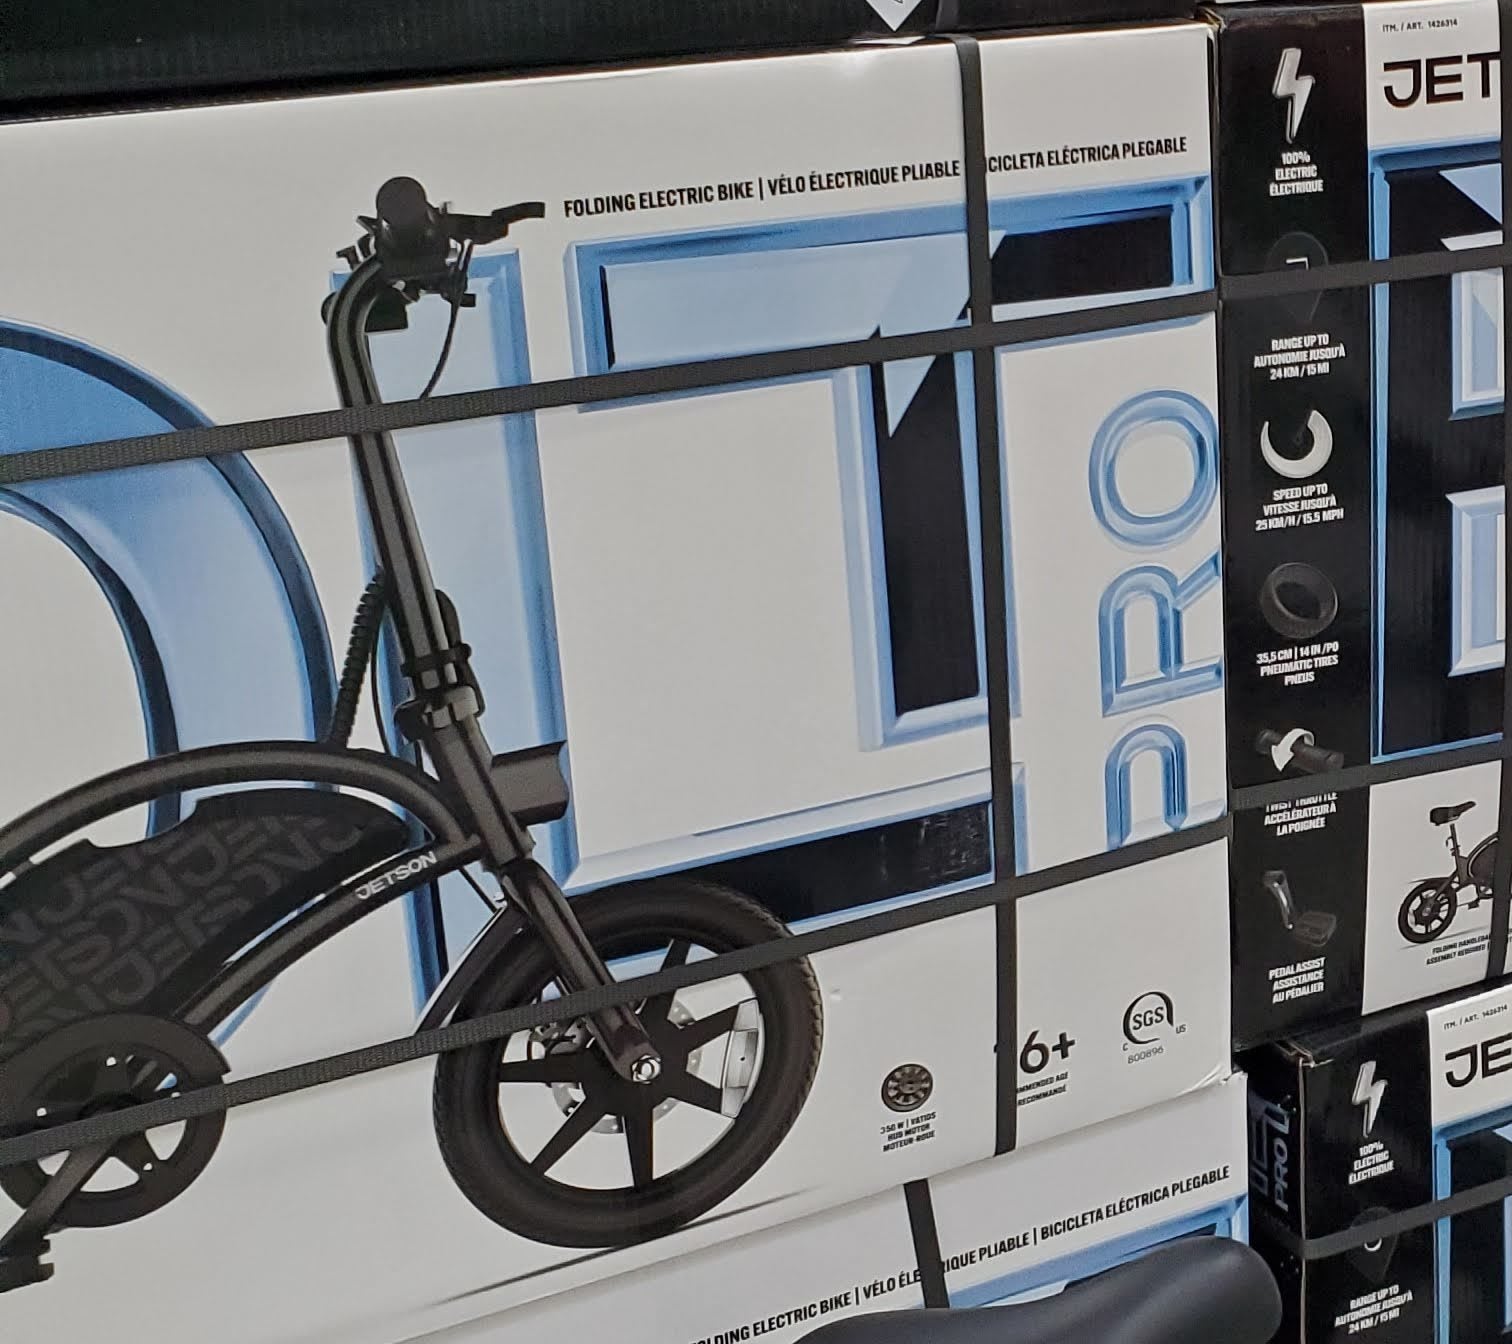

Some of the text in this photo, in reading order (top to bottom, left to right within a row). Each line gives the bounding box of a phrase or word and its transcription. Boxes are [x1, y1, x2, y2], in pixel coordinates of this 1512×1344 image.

[1382, 18, 1458, 33] ITM. ART. 1426314
[1281, 151, 1311, 165] 100%
[564, 135, 1188, 218] FOLDING ELECTRIC BIKE VÉLO ÉLECTRIQUE PLIABLE ELÉCTRICA PLEGABLE
[1275, 164, 1318, 181] ELECTRIC
[1269, 178, 1324, 197] ÉLECTRIQUE
[1271, 333, 1329, 352] RANGE UP TO
[1254, 342, 1346, 369] AUTONOMIE JUSQU'À
[1270, 361, 1330, 381] 24 KM 15 MI
[1273, 483, 1328, 501] SPEED UP TO
[1262, 494, 1337, 517] VITESSE JUSQU'À
[1255, 507, 1344, 532] 25 KM/H 15.5 MPH
[1260, 654, 1339, 679] PNEUMATIC TIRES
[1284, 670, 1315, 688] PNEUS
[1276, 815, 1326, 836] LA POIGNÉE
[354, 851, 438, 901] JETSON
[1268, 958, 1325, 981] PEDAL ASSIST
[1273, 969, 1324, 992] ASSISTANCE
[1273, 980, 1325, 1004] AU PÉDALIER
[1133, 1007, 1164, 1031] SGS
[1354, 1153, 1390, 1171] ELECTRIC
[1359, 1143, 1384, 1159] 100%
[1348, 1160, 1394, 1185] ÉLECTRIQUE
[753, 1302, 818, 1338] ELECTRIC
[820, 1291, 853, 1318] BIKE
[863, 1277, 896, 1305] VÉLO
[979, 1231, 1031, 1263] PLIABLE
[1041, 1208, 1104, 1241] BICICLETA
[1105, 1186, 1170, 1218] ELÉCTRICA
[1171, 1165, 1231, 1197] PLEGABLE
